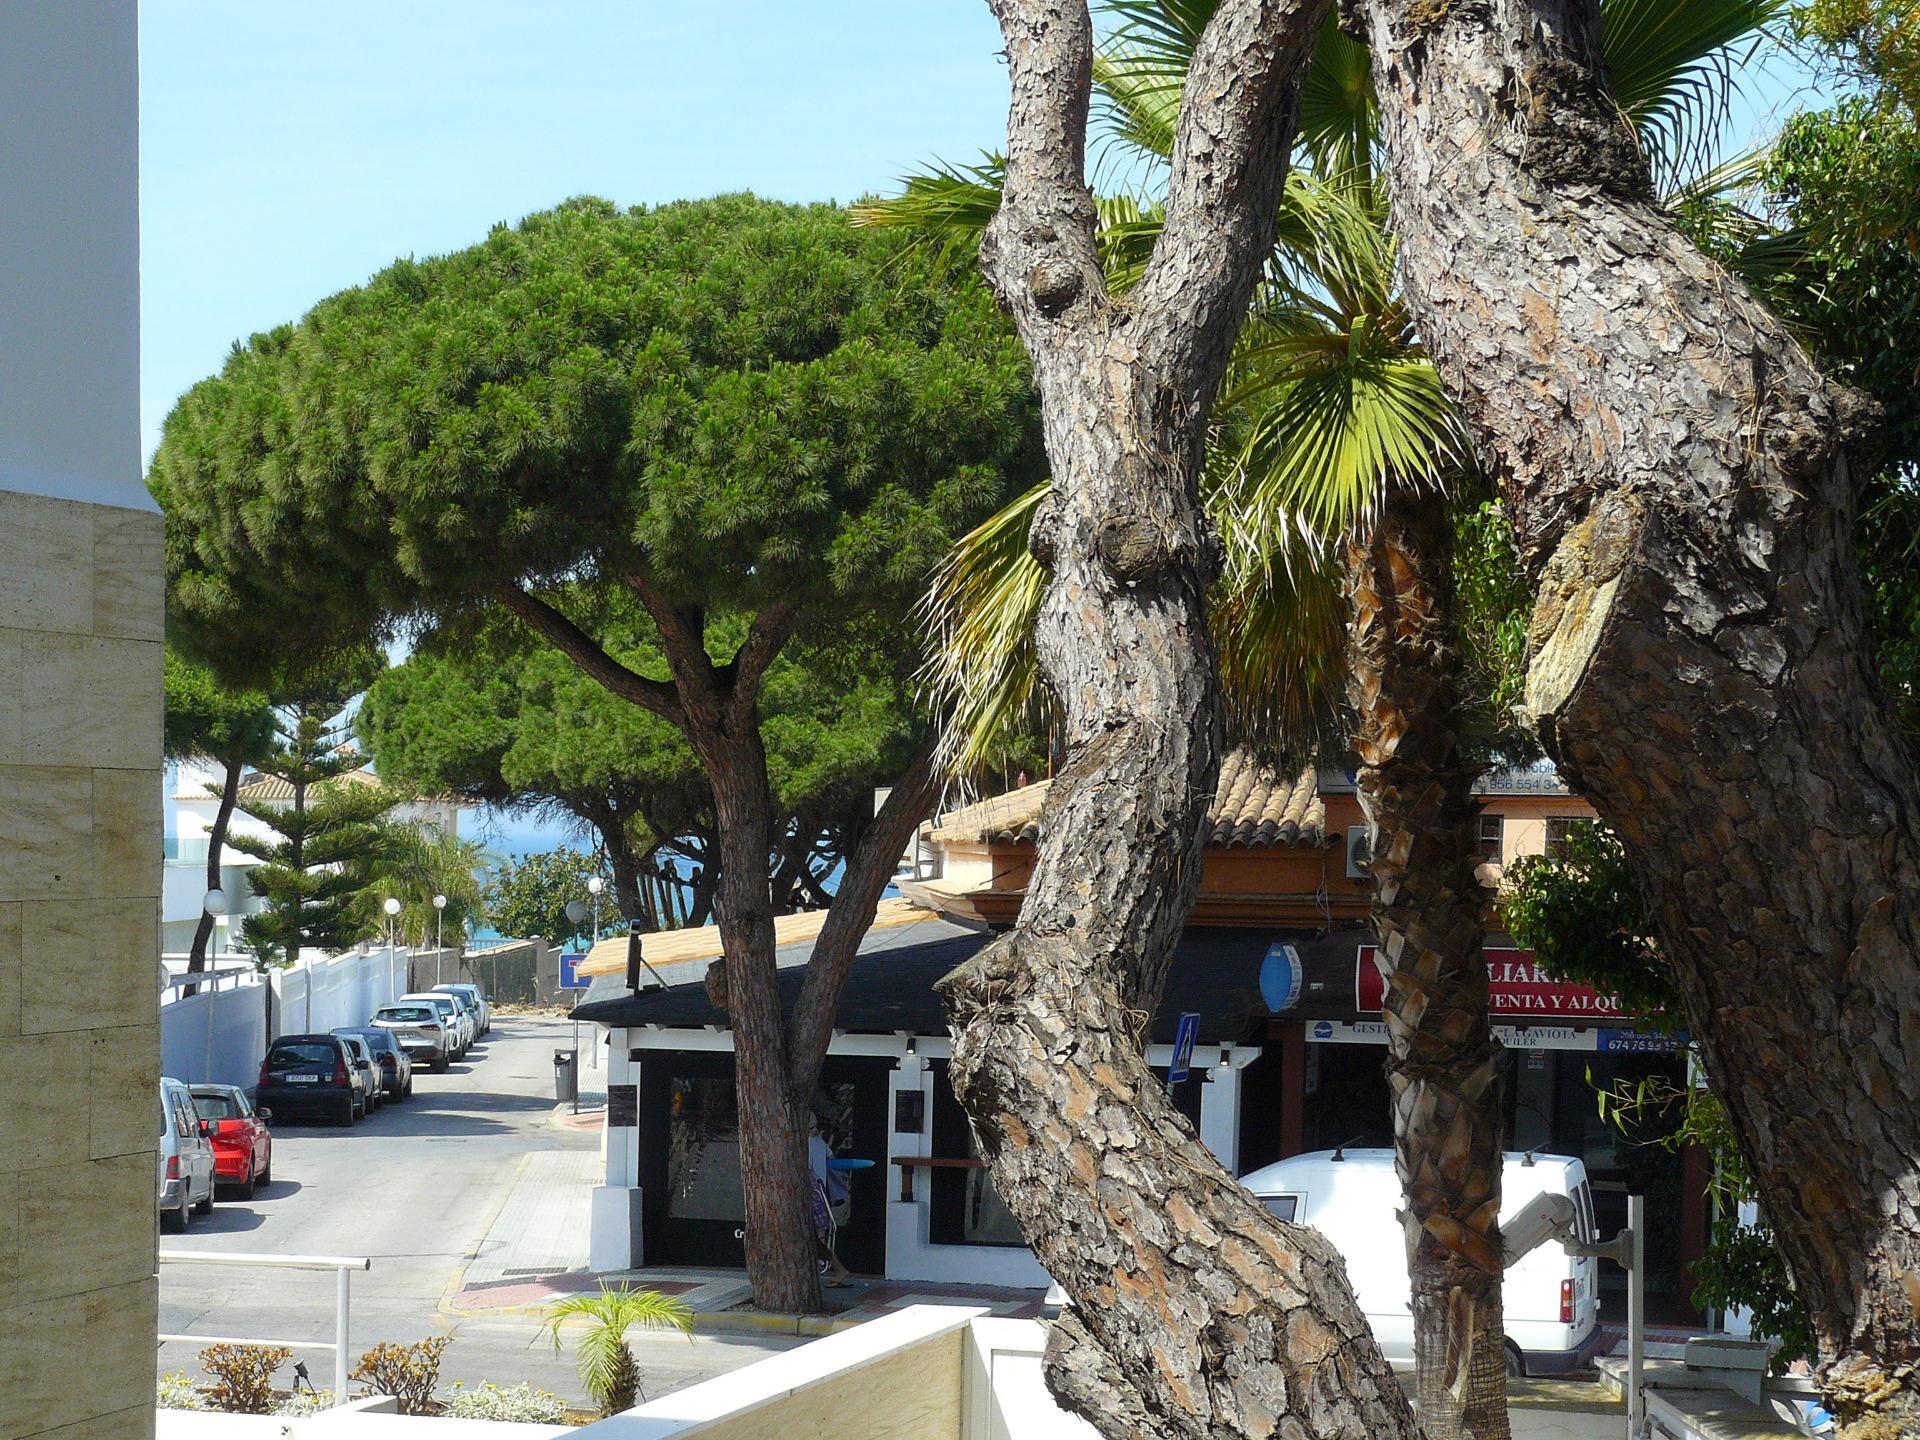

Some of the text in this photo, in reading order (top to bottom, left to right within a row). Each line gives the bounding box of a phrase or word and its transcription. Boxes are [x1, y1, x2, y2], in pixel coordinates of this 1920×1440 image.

[1489, 780, 1513, 790] 956
[1516, 780, 1539, 790] 554
[1550, 995, 1564, 1009] Y
[1521, 1028, 1576, 1040] GAVIOTA
[1608, 1040, 1630, 1050] 674
